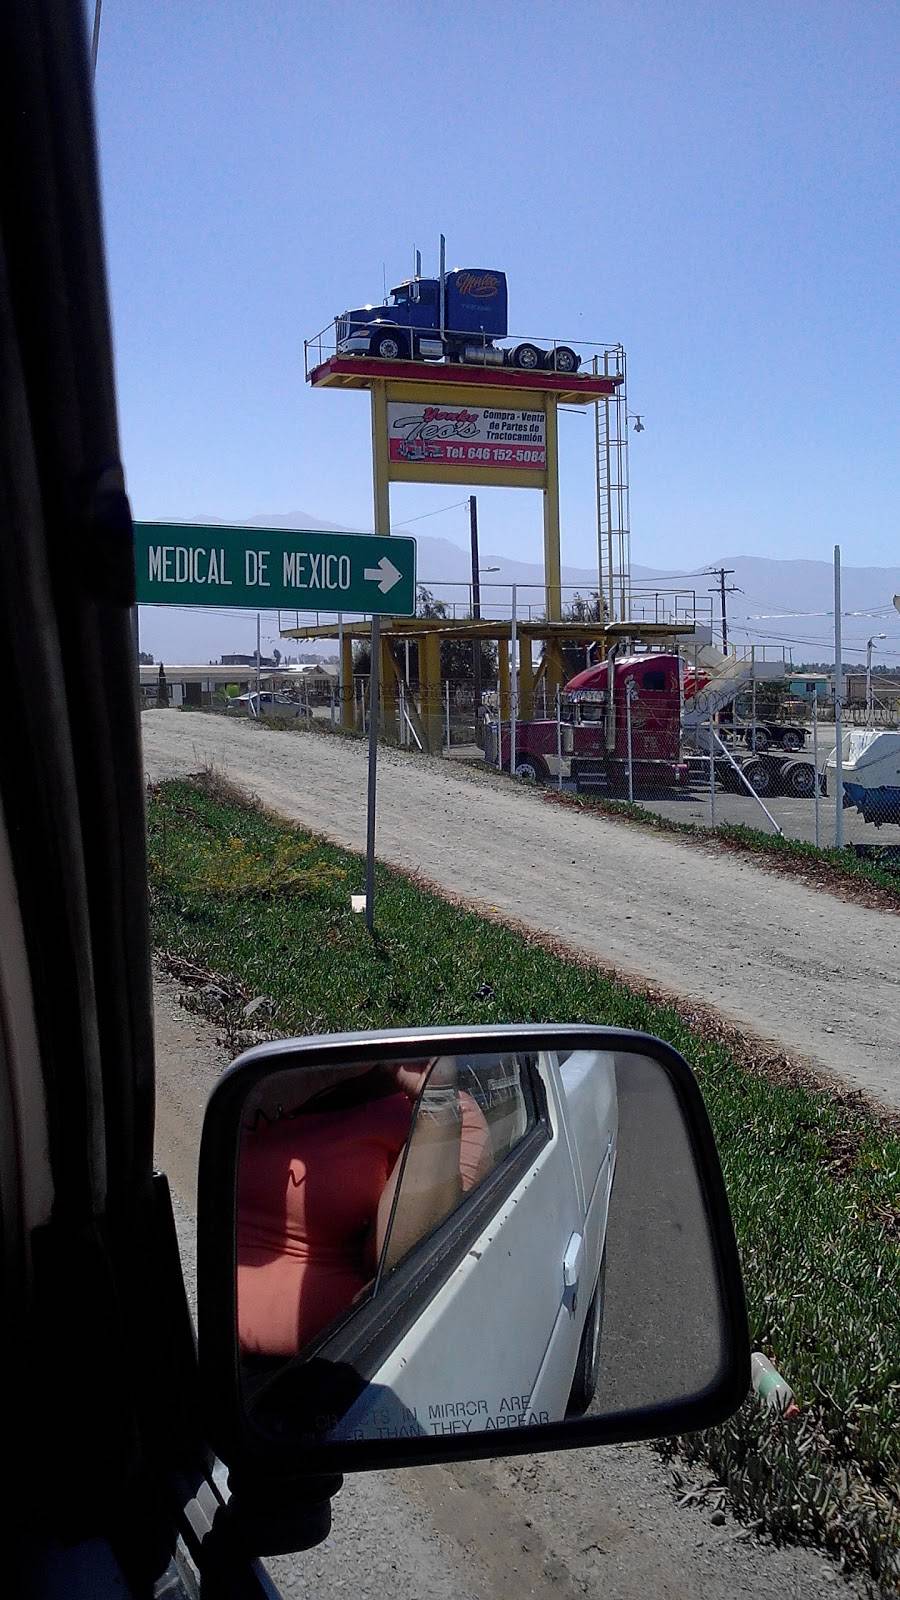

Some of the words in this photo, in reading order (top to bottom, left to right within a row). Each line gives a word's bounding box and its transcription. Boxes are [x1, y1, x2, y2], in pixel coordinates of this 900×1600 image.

[483, 410, 515, 423] Compra
[521, 412, 545, 423] Venta
[489, 420, 500, 430] de
[501, 421, 527, 432] Partes
[529, 423, 540, 433] de
[393, 415, 480, 441] Teo's
[486, 430, 543, 443] Tractocamión
[446, 446, 465, 459] Tel.
[468, 447, 491, 460] 646
[148, 545, 233, 585] MEDICAL
[245, 550, 271, 587] DE
[283, 552, 351, 590] MEXICO
[400, 1406, 418, 1422] IN
[428, 1400, 489, 1420] MIRROR
[499, 1394, 533, 1413] ARE
[376, 1423, 421, 1438] THAN
[430, 1419, 472, 1436] THEY
[485, 1411, 550, 1431] APPEAR
